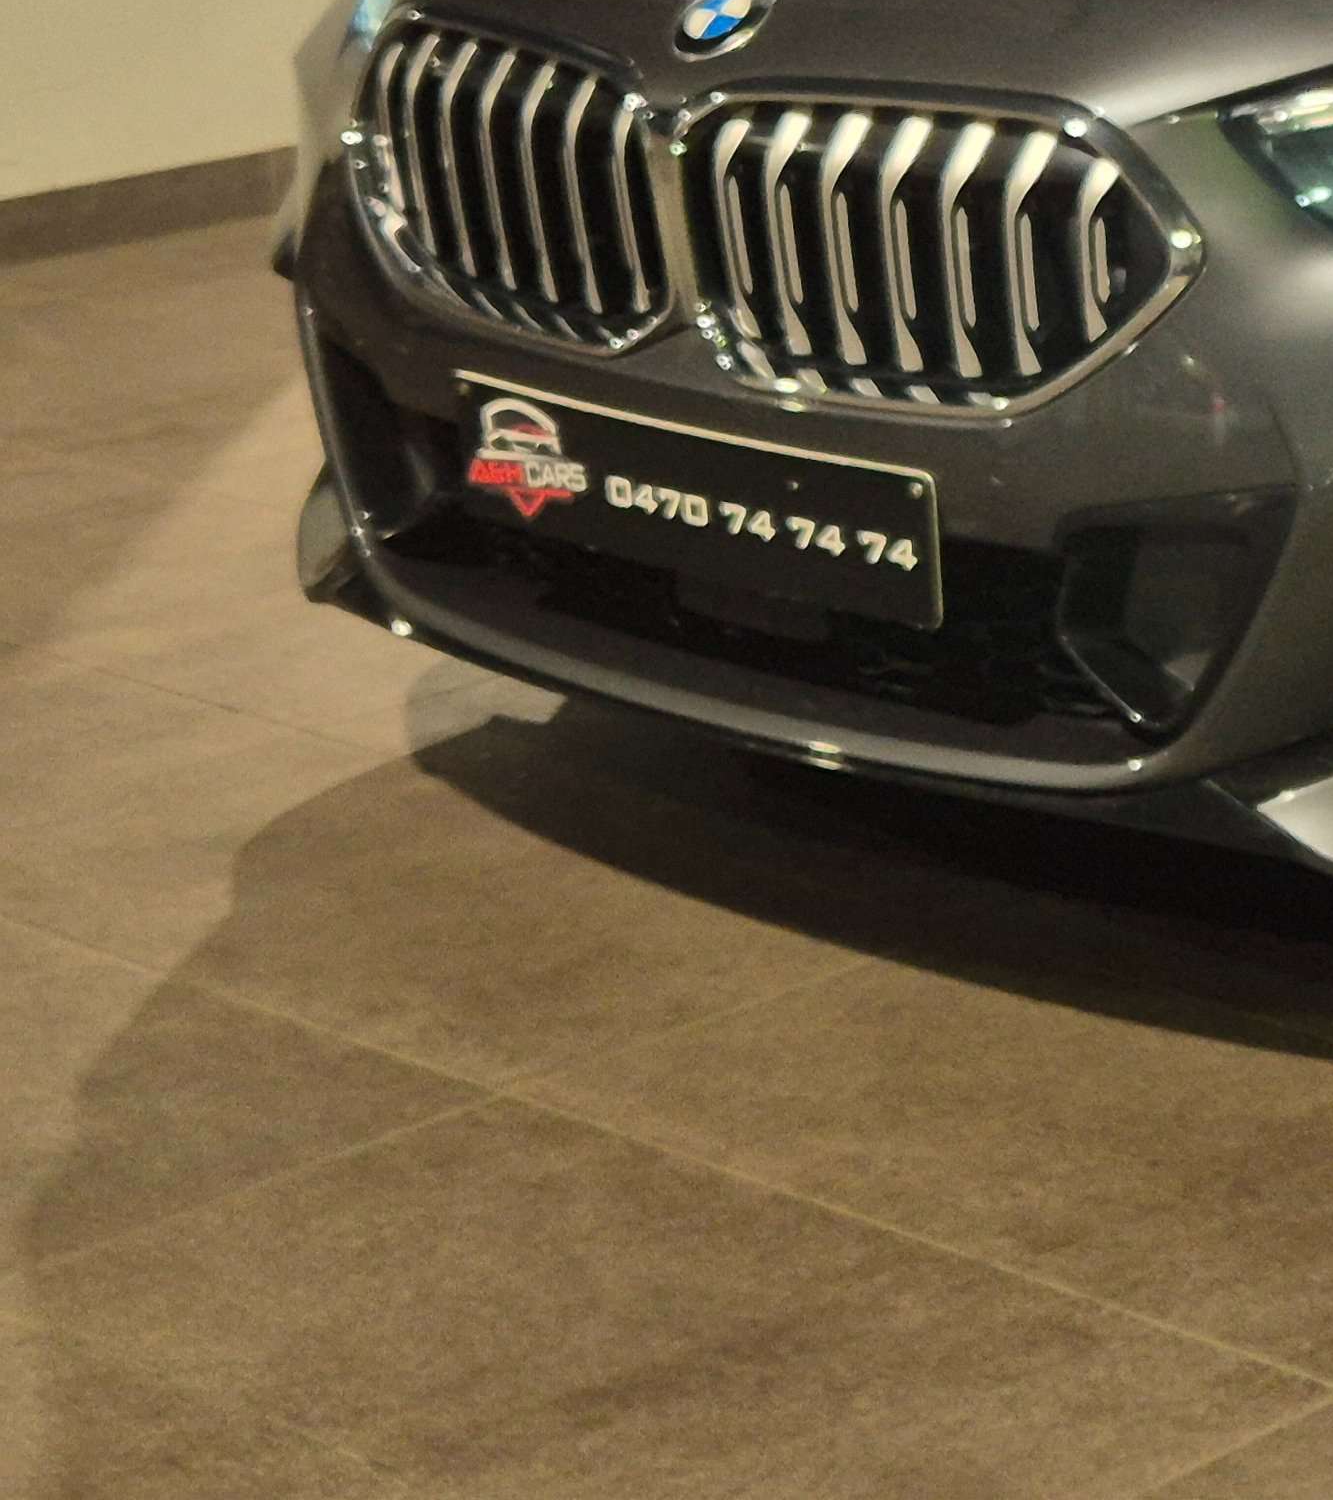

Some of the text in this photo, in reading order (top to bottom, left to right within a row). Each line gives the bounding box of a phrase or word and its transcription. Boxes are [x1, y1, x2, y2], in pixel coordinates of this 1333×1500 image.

[604, 475, 918, 571] 0470 74 74 74
